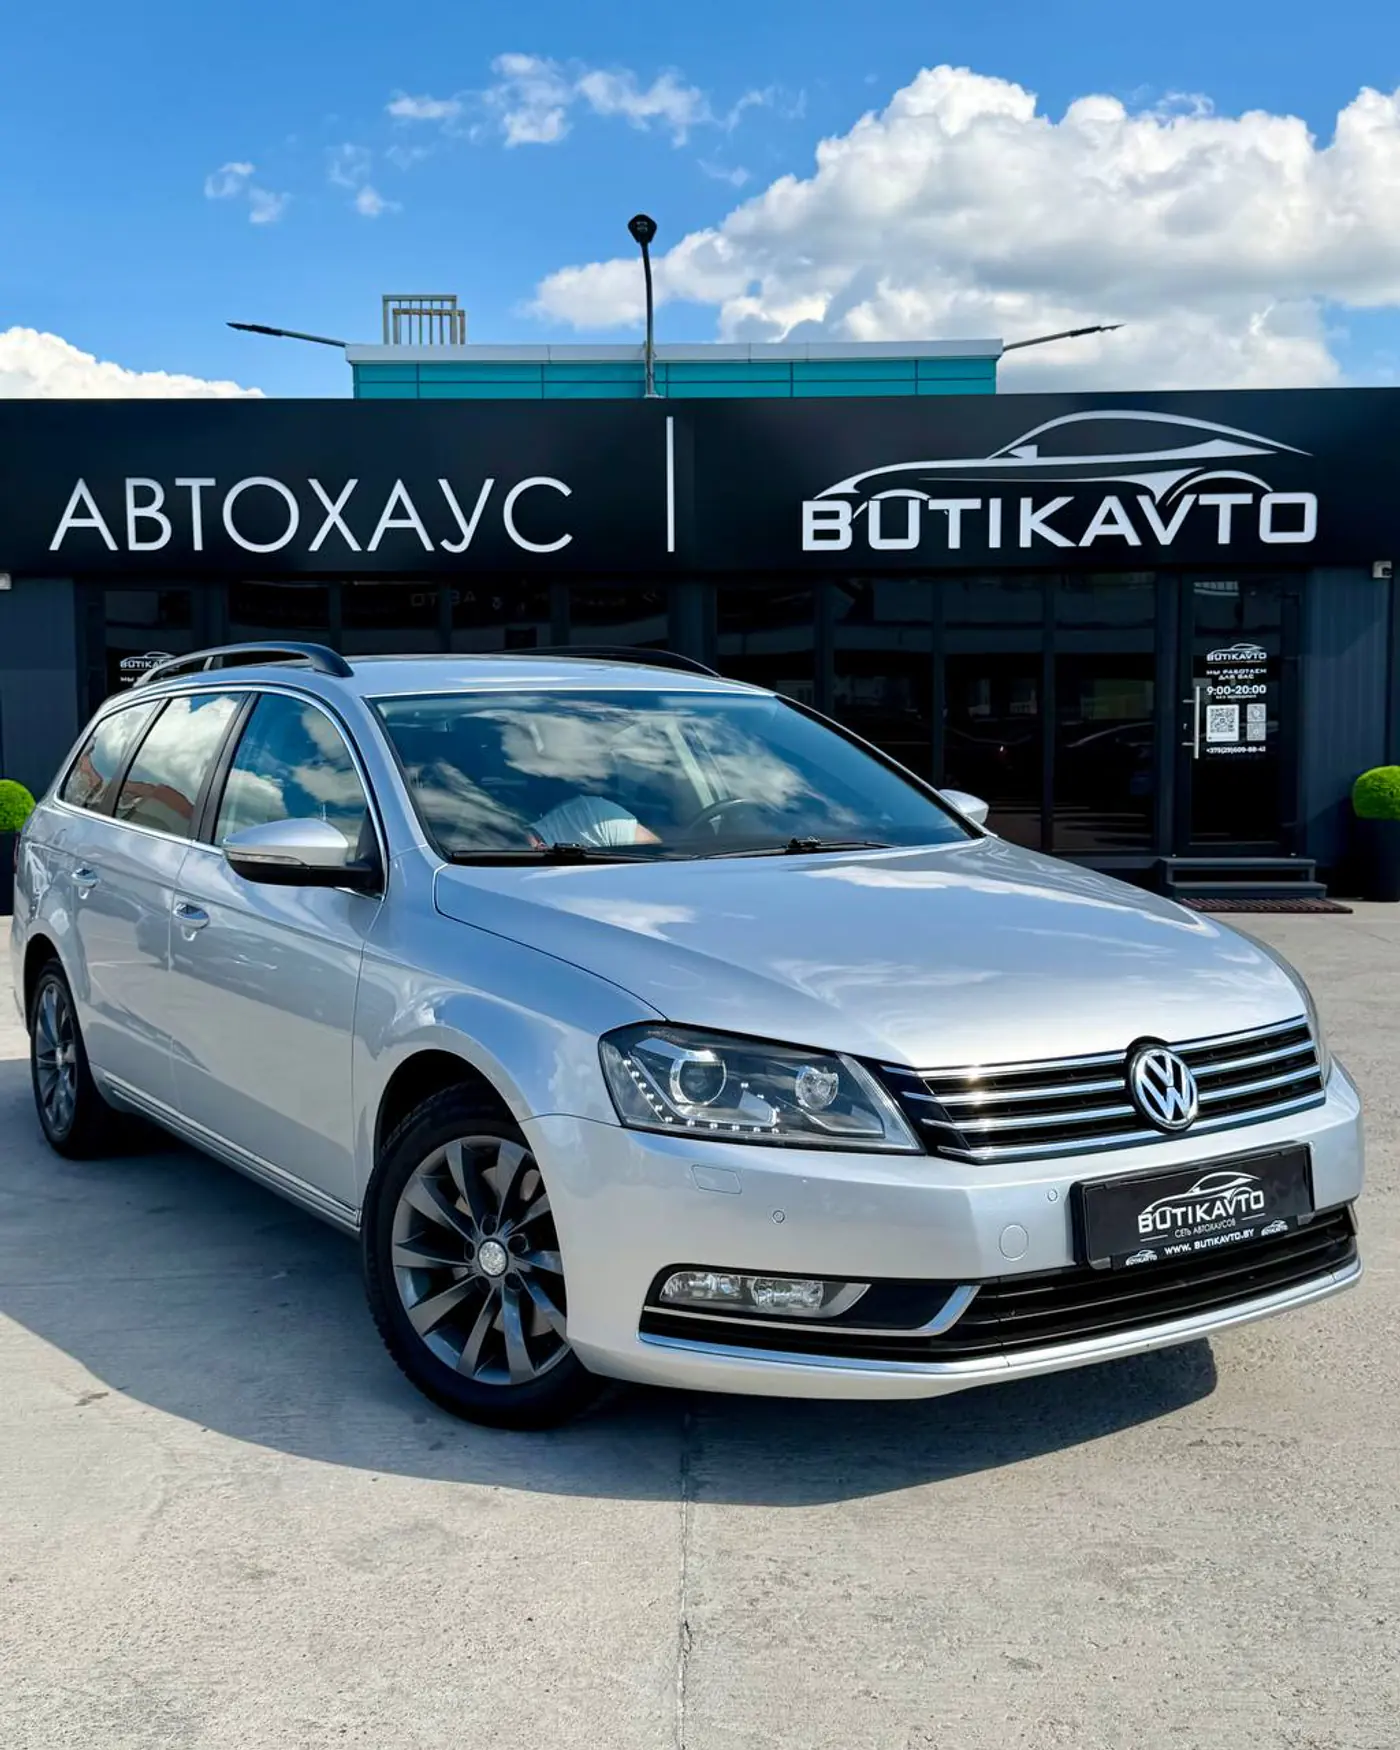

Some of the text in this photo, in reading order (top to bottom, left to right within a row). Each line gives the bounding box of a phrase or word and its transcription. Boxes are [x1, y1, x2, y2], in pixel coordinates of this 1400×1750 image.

[49, 475, 573, 554] АВТОХАУС
[802, 491, 1318, 552] BUTIKAVTO
[1206, 652, 1267, 662] BUTIKAVTO
[1206, 684, 1267, 696] 9:00-20:00
[1138, 1189, 1265, 1234] BUTIKAVTO
[1174, 1227, 1192, 1239] СЕТЬ
